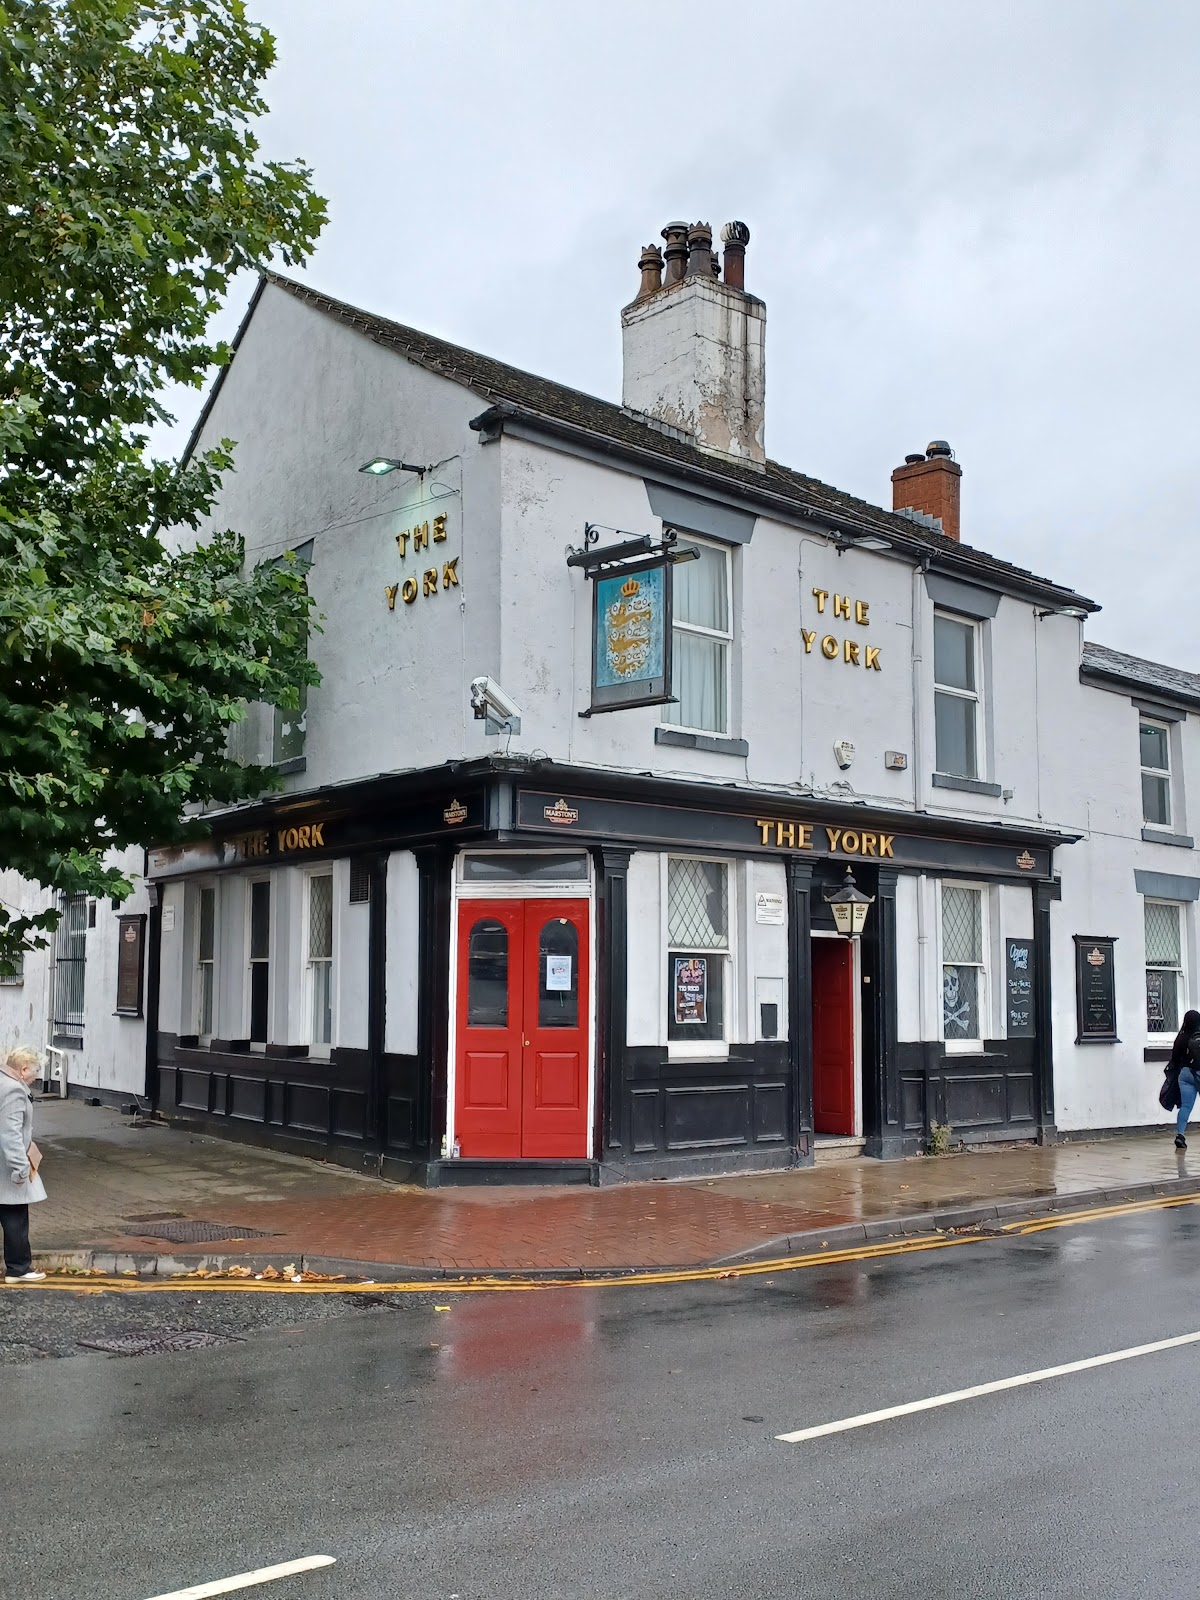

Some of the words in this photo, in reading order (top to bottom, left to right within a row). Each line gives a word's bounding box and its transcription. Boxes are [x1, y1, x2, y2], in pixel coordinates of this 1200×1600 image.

[395, 511, 447, 558] THE
[384, 556, 460, 610] YORK
[812, 587, 870, 626] THE
[800, 627, 882, 671] YORK
[545, 809, 577, 819] MARSTON'S
[239, 831, 269, 858] THE
[278, 823, 324, 852] YORK
[757, 820, 813, 849] THE
[825, 827, 895, 858] YORK
